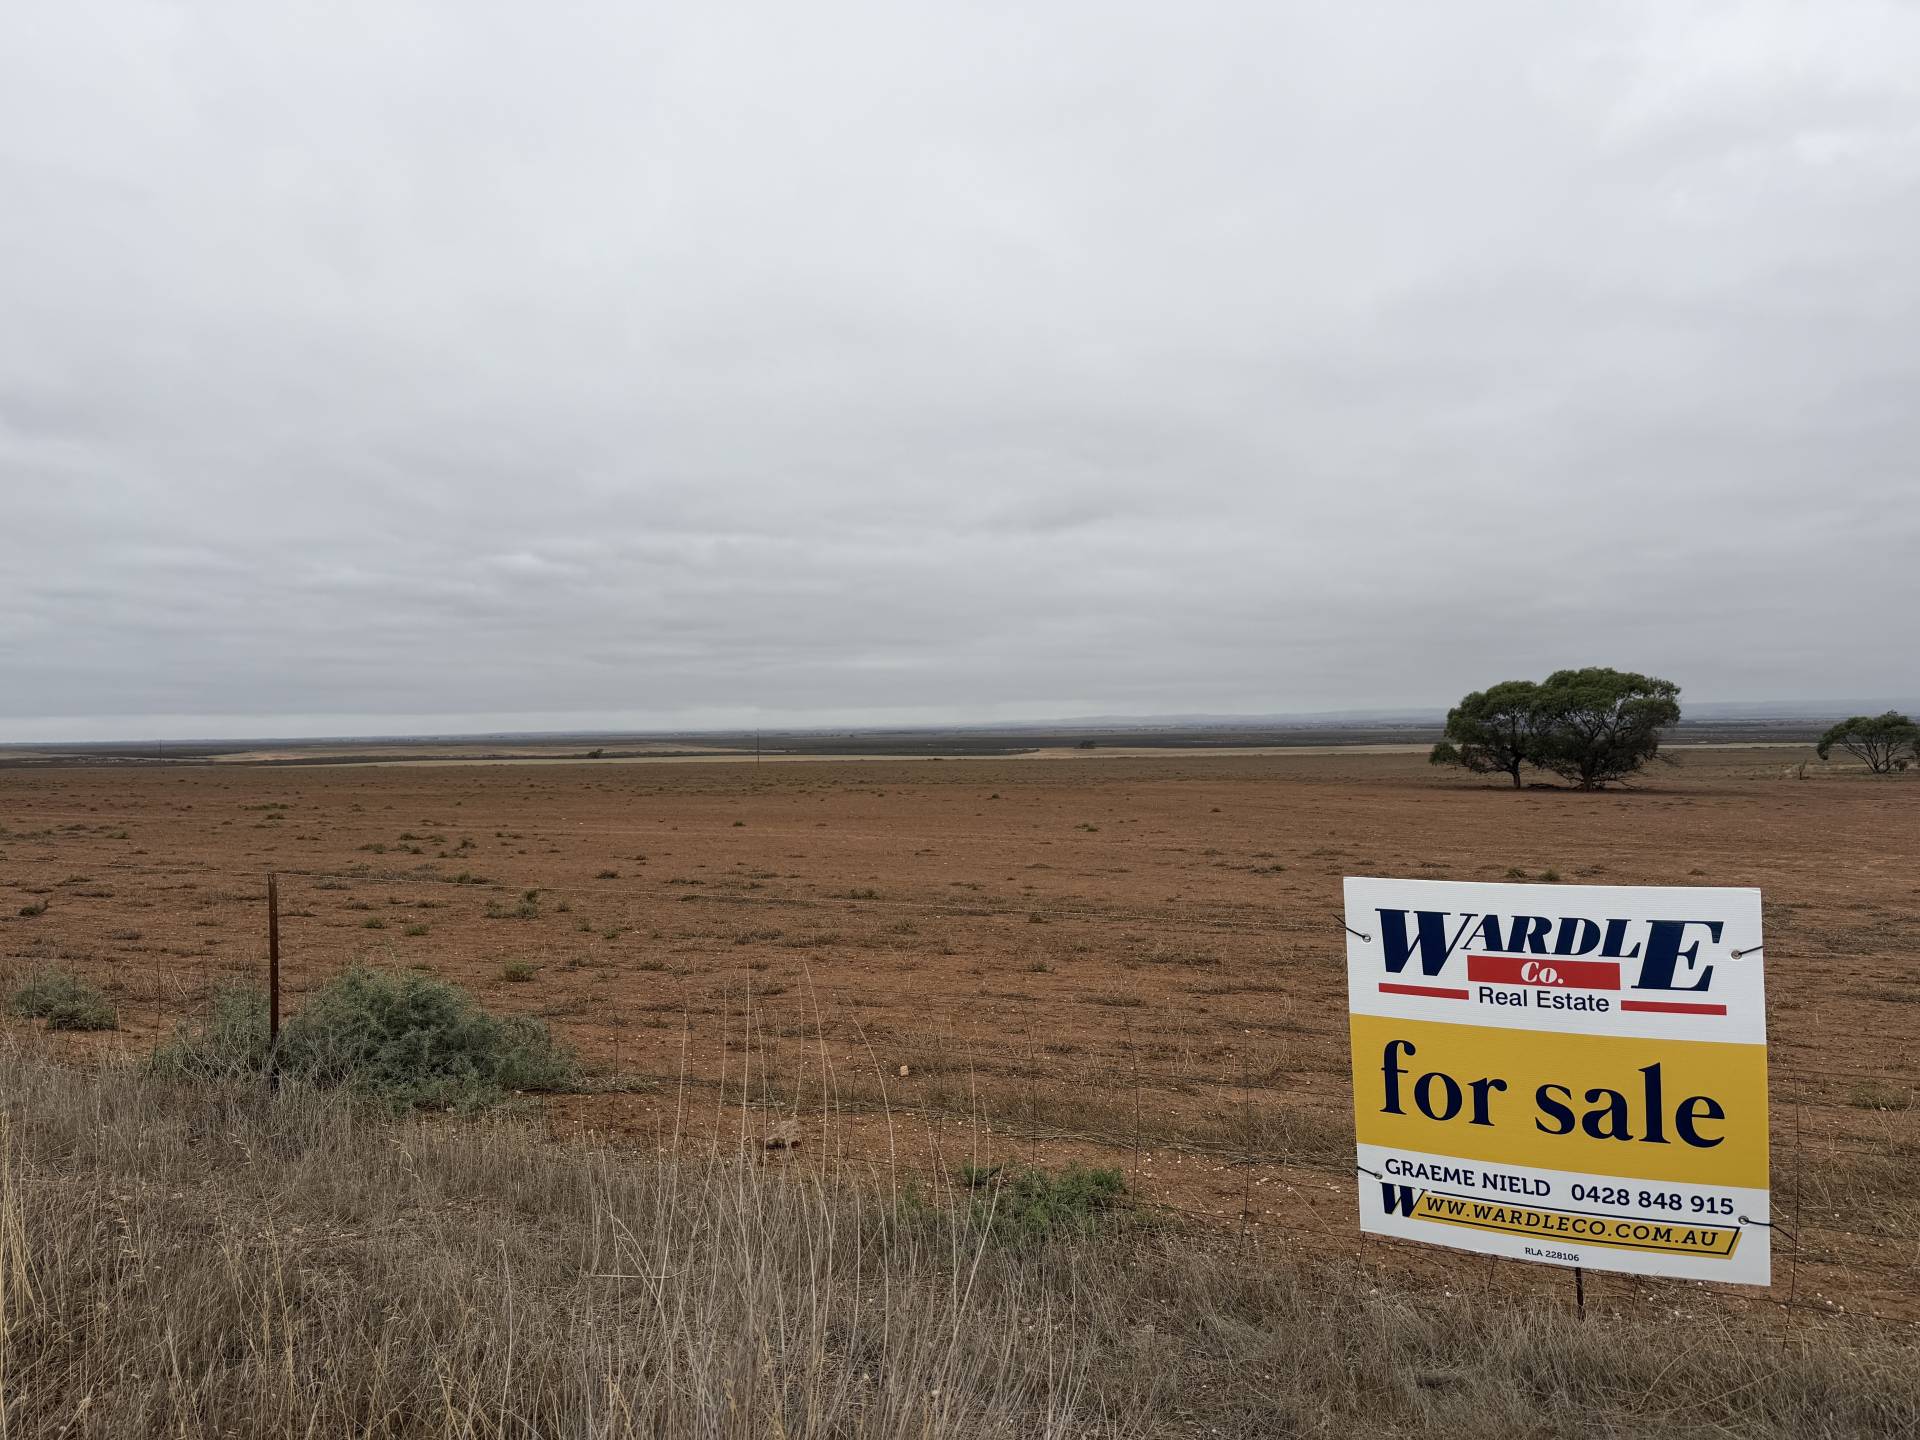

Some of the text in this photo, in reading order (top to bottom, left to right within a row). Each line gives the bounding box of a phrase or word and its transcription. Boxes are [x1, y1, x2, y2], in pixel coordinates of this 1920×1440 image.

[1375, 907, 1724, 992] WARDLE
[1520, 961, 1564, 985] Co.
[1479, 986, 1610, 1013] Real Estate
[1379, 1039, 1726, 1148] for sale
[1379, 1182, 1719, 1247] WWW.WARDLECO.COM.AU
[1385, 1158, 1734, 1215] GRAEME NIELD 0428 848 915
[1524, 1246, 1580, 1262] RLA 228106
